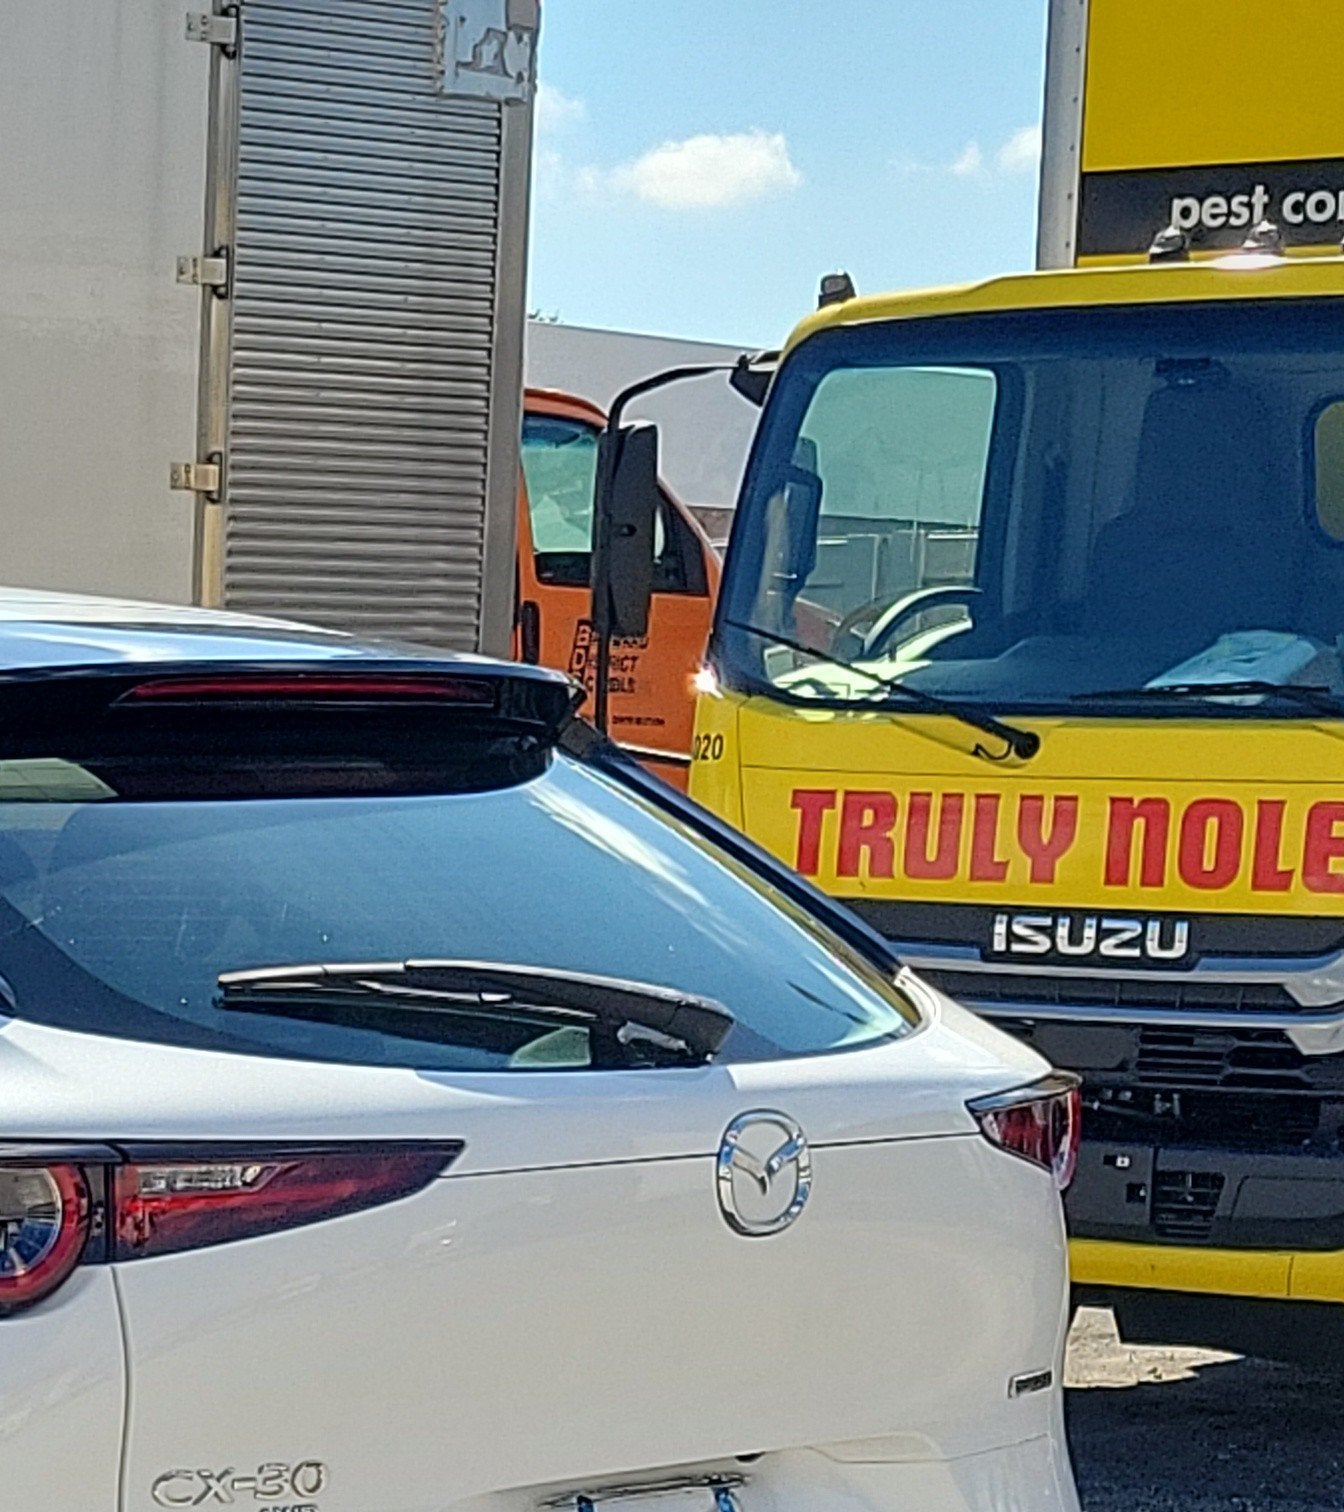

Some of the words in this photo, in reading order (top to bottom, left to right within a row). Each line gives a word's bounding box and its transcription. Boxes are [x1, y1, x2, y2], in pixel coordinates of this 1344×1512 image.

[1171, 185, 1270, 229] pest
[1282, 190, 1344, 225] co
[791, 789, 1078, 885] TRULY
[992, 914, 1190, 959] ISUZU
[151, 1460, 329, 1508] CX-30
